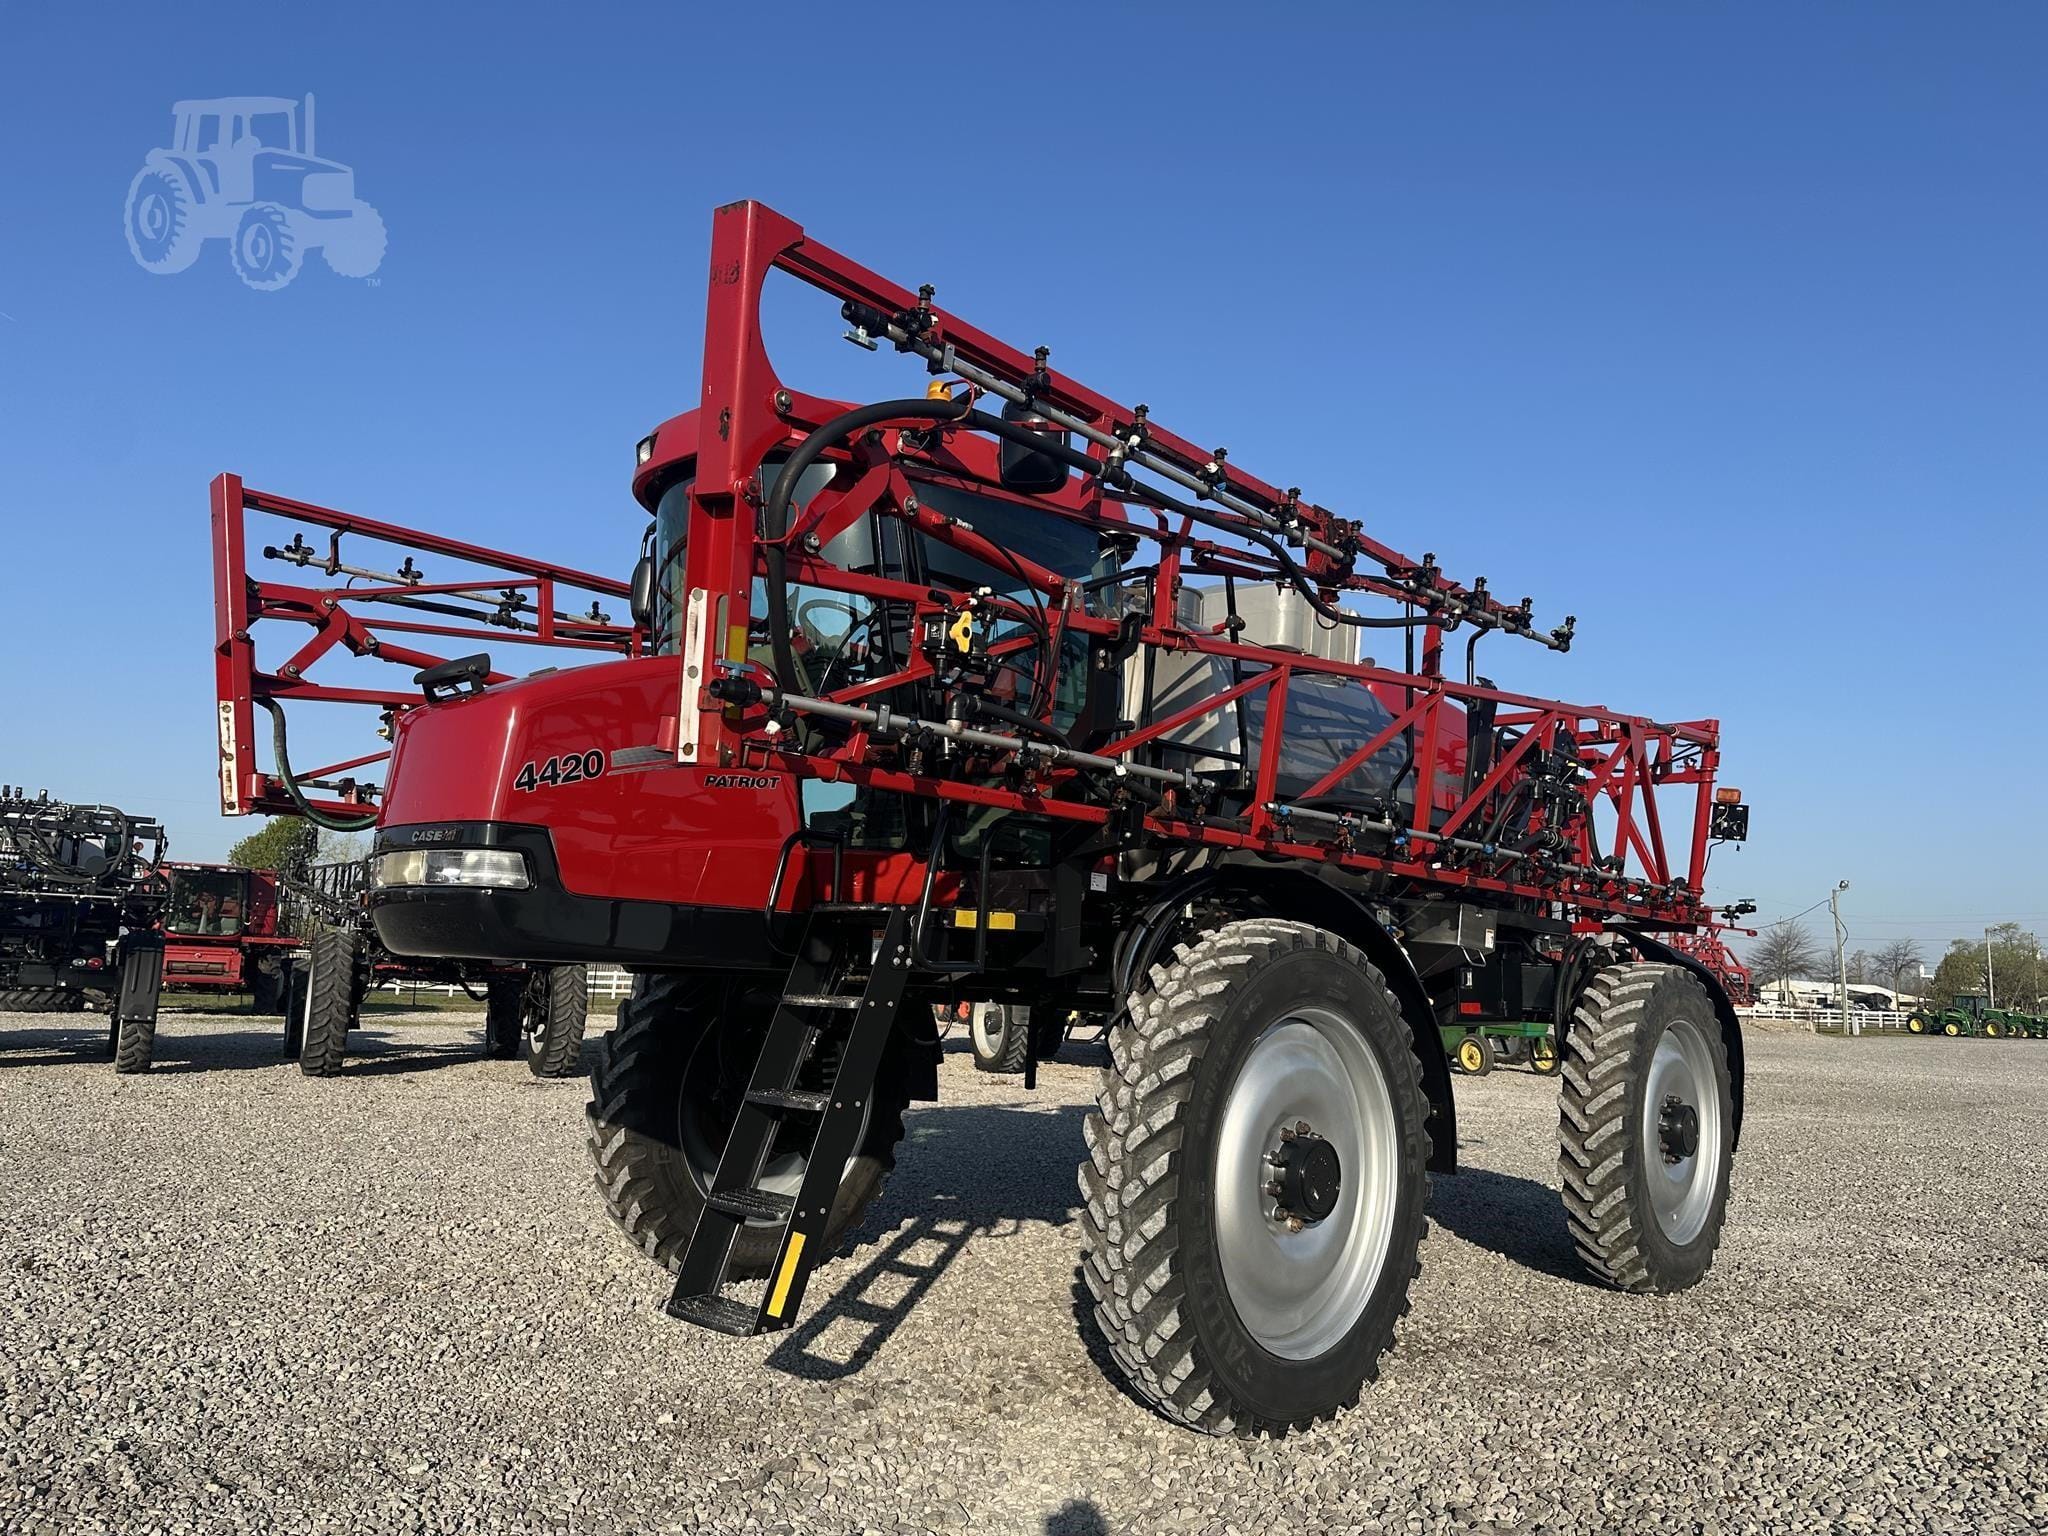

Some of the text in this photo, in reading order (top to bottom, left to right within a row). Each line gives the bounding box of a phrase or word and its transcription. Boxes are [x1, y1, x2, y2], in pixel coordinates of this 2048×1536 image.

[514, 748, 605, 793] 4420
[704, 774, 781, 789] PATRIOT
[411, 830, 443, 842] CASE
